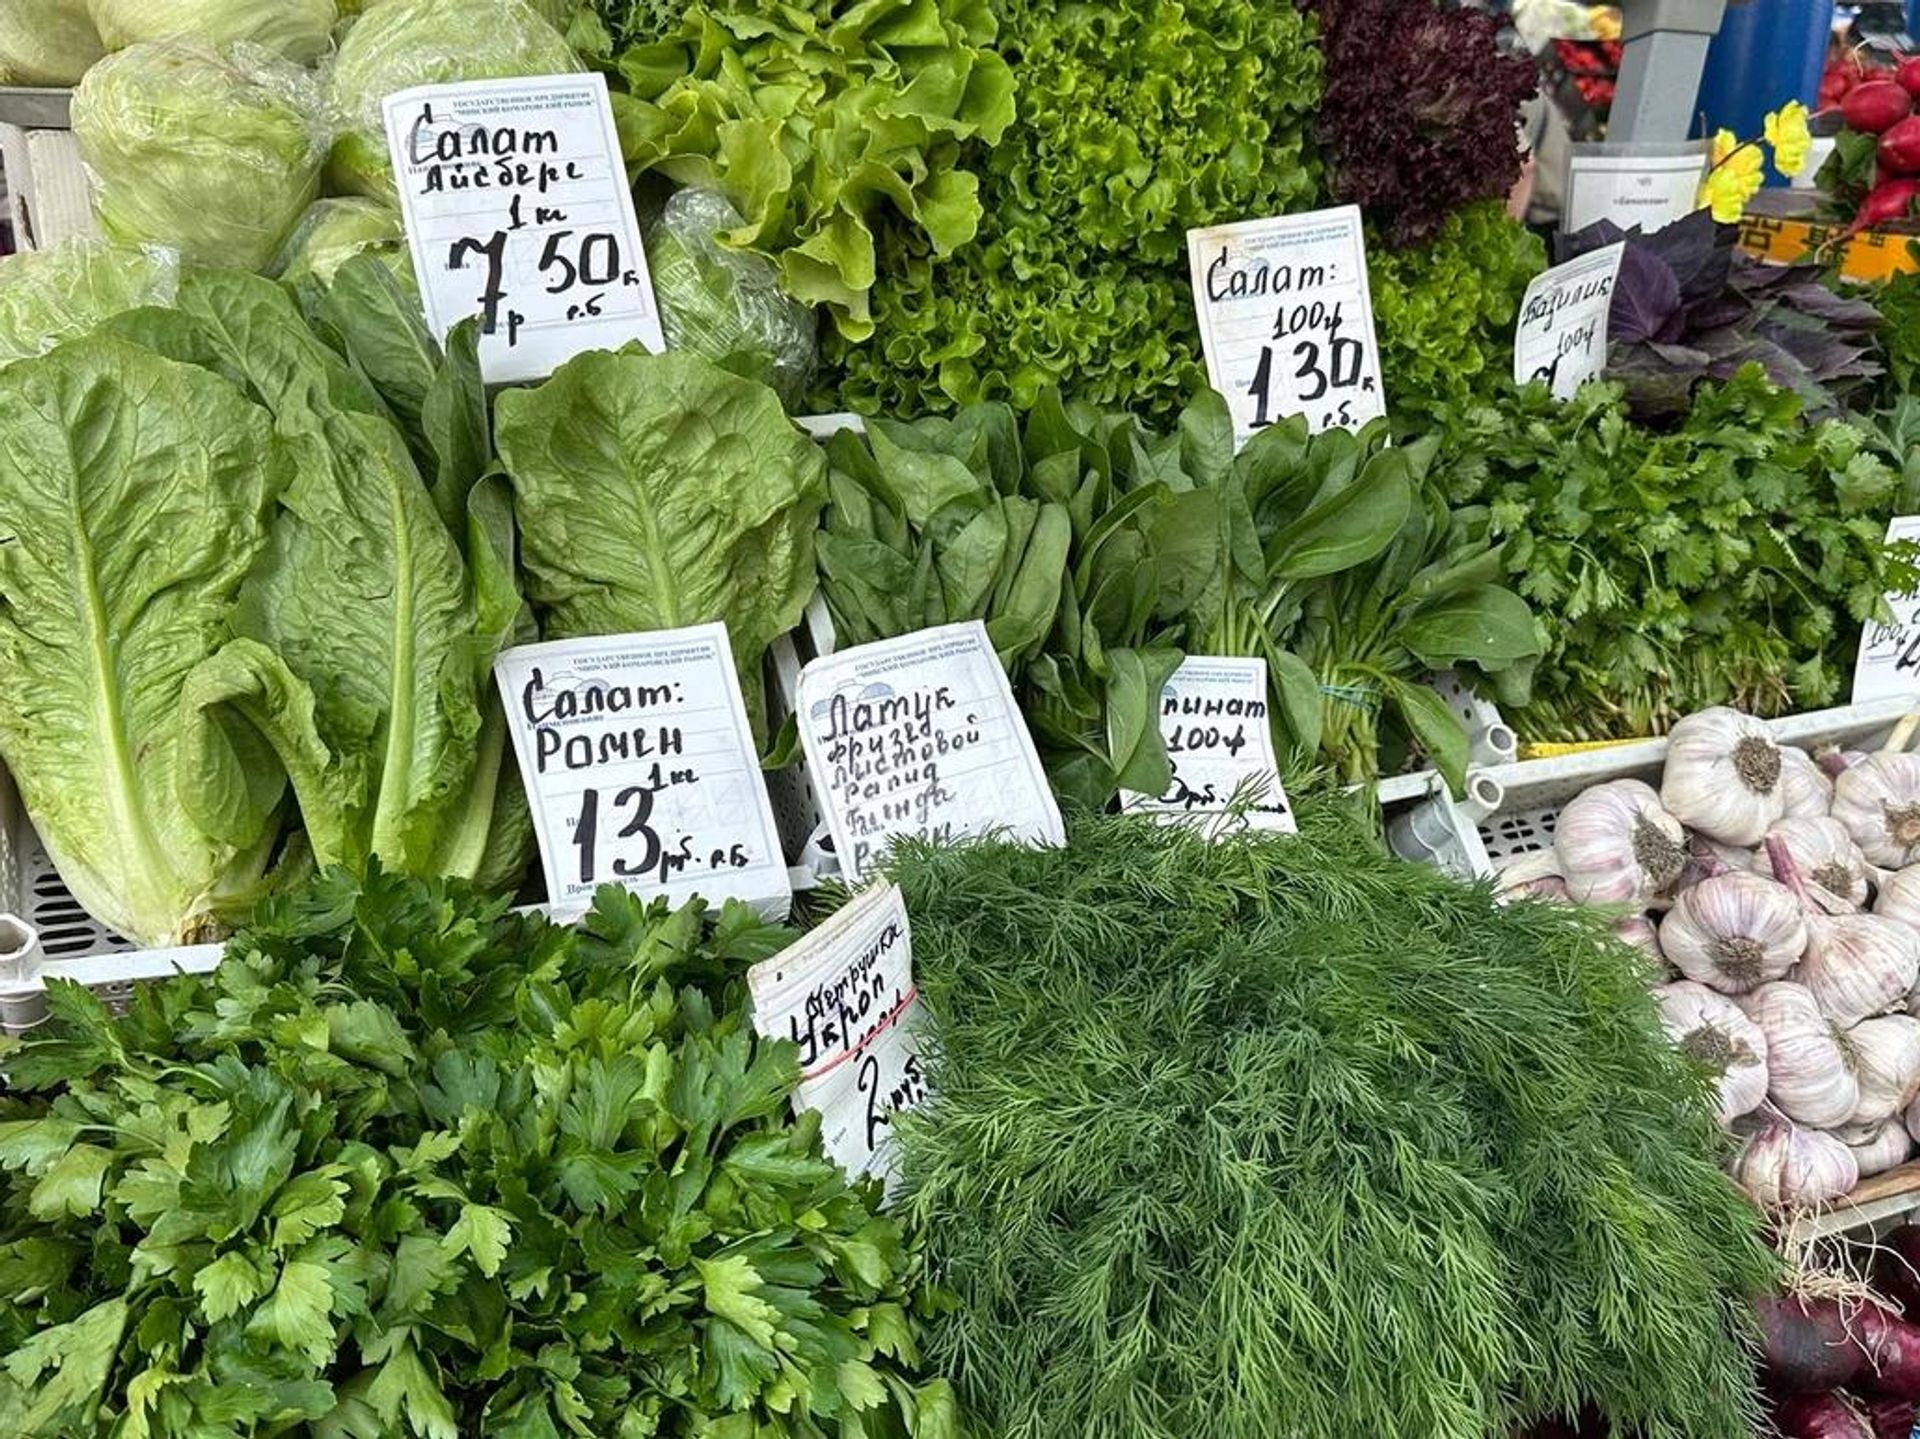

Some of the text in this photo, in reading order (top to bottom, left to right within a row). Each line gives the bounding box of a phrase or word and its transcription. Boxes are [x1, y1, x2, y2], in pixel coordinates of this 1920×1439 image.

[409, 103, 558, 164] Салат
[420, 156, 584, 194] Айсберг
[507, 194, 527, 230] 1
[449, 231, 508, 334] 7
[1207, 246, 1337, 302] Салат:
[1248, 346, 1274, 428] 1
[523, 667, 684, 725] Салат:
[825, 687, 955, 741] Латук
[1163, 696, 1265, 718] пинат
[648, 762, 669, 792] 1
[572, 786, 661, 883] 13
[790, 972, 884, 1066] Укроп
